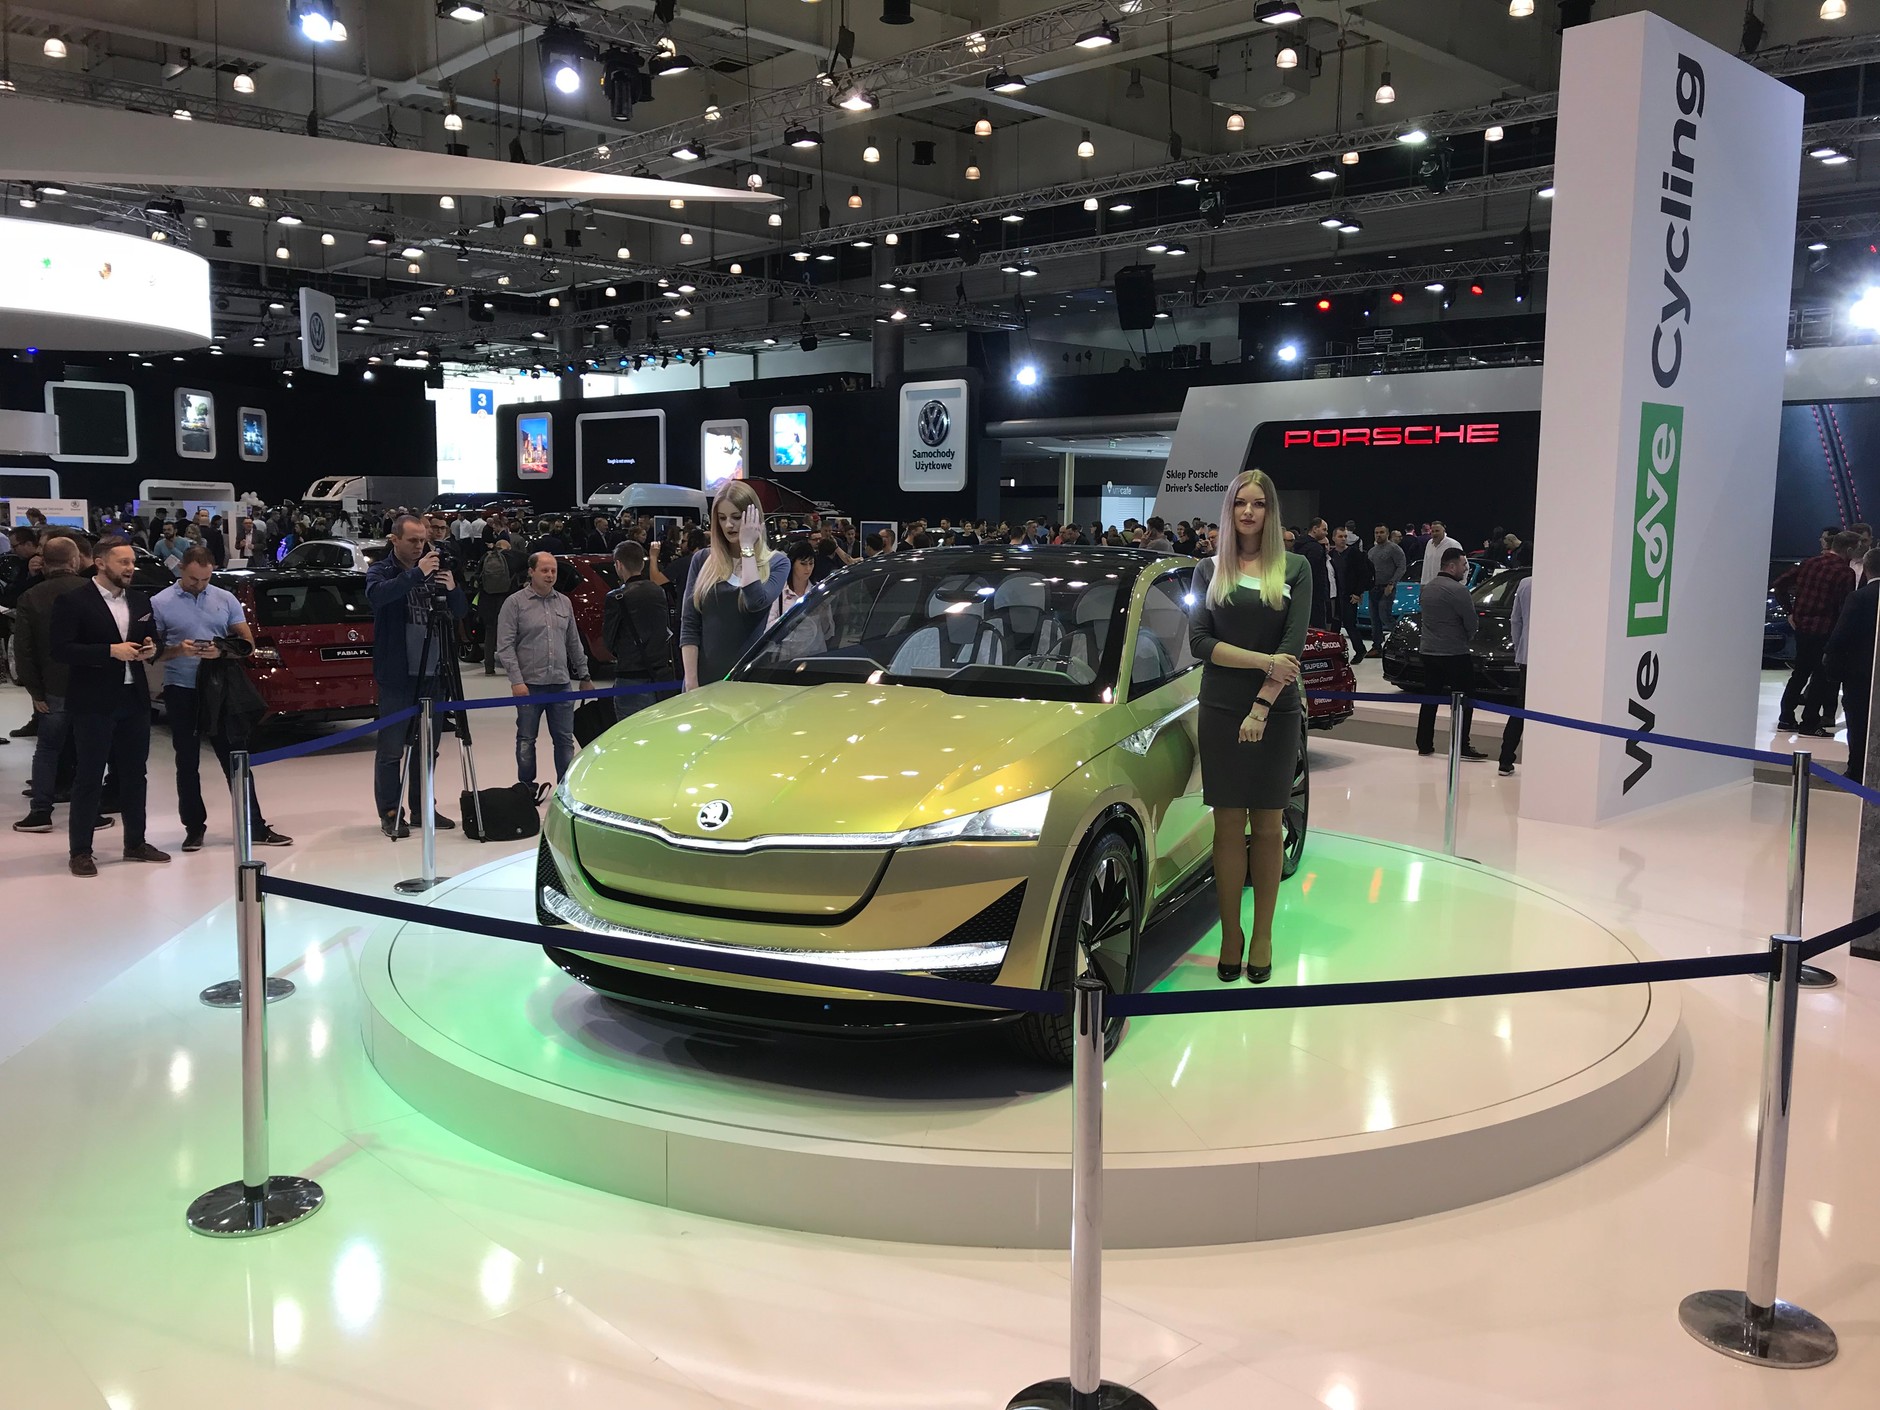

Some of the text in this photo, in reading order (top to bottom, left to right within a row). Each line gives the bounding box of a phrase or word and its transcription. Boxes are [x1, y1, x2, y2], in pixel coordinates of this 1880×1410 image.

[477, 393, 487, 407] 3
[1622, 650, 1660, 796] We
[1651, 52, 1705, 388] Cycling
[1284, 424, 1500, 448] PORSCHE
[912, 448, 956, 460] Samochody
[915, 461, 952, 472] Użytkowe
[1166, 469, 1218, 480] Sklep Porsche
[1165, 483, 1228, 492] Driver's Selection
